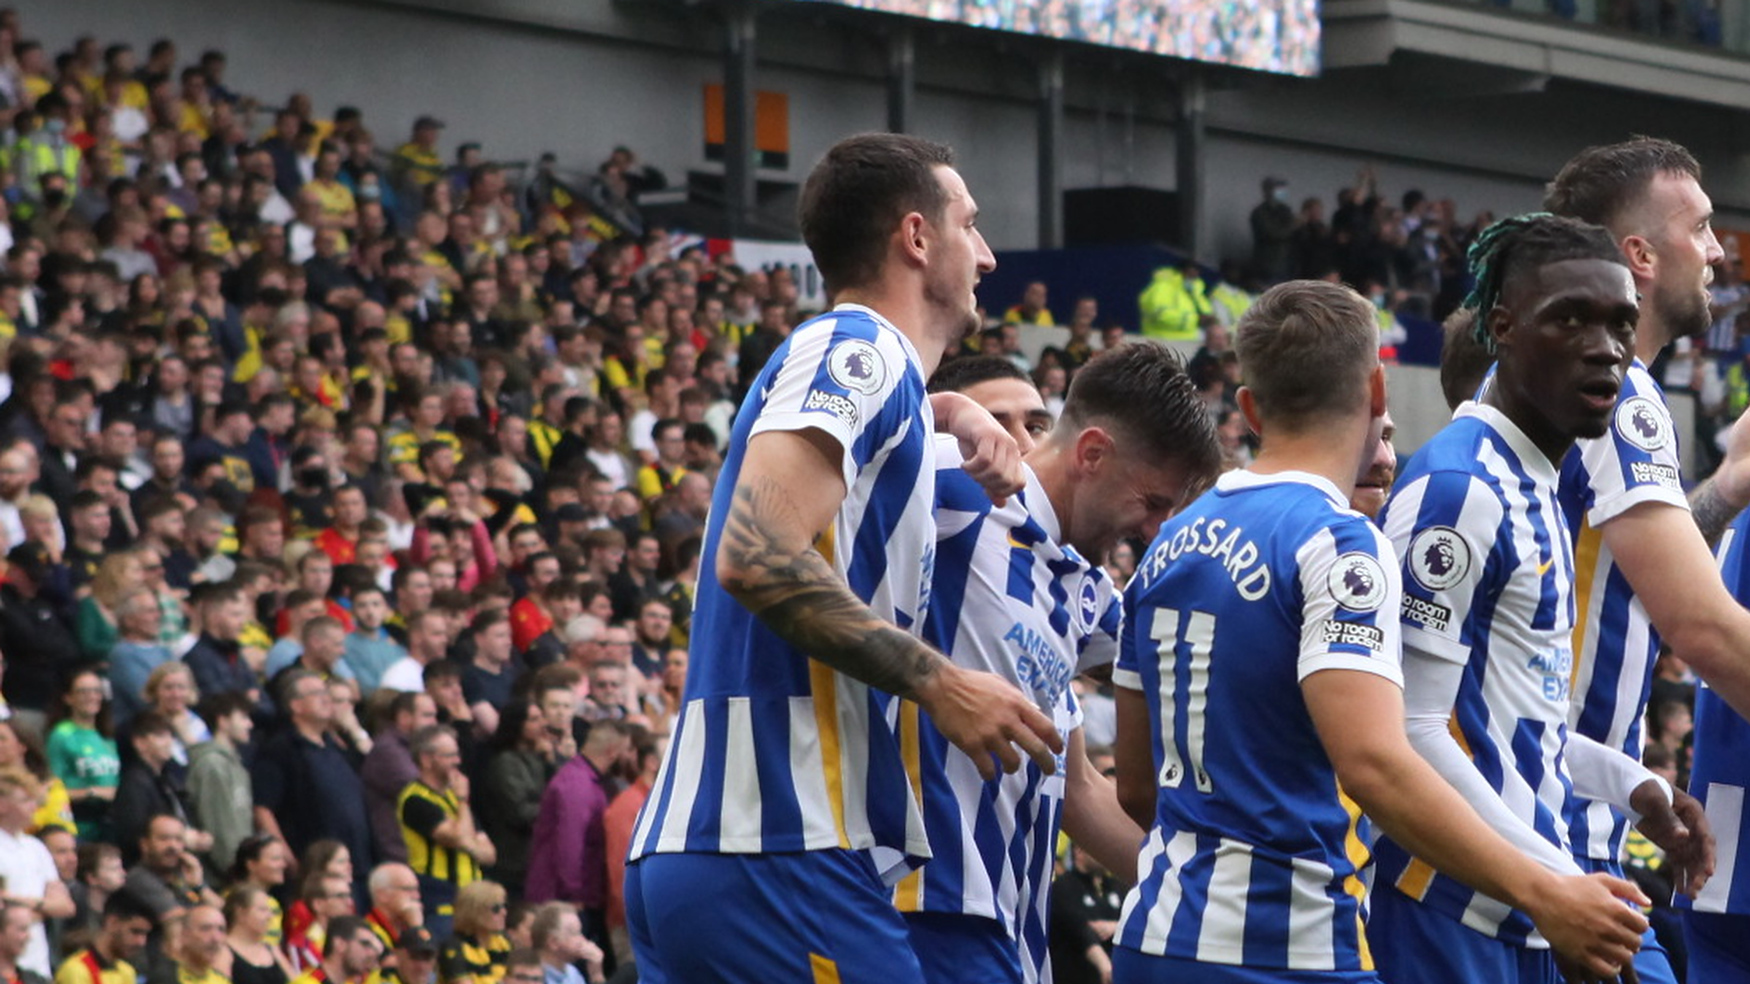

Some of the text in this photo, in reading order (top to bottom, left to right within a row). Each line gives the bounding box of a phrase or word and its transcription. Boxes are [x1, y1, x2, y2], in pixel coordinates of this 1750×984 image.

[1138, 516, 1271, 602] TROSSARD
[1323, 620, 1380, 641] No room
[1412, 598, 1447, 620] room
[1003, 621, 1073, 690] AMERICA
[1150, 607, 1217, 794] 11
